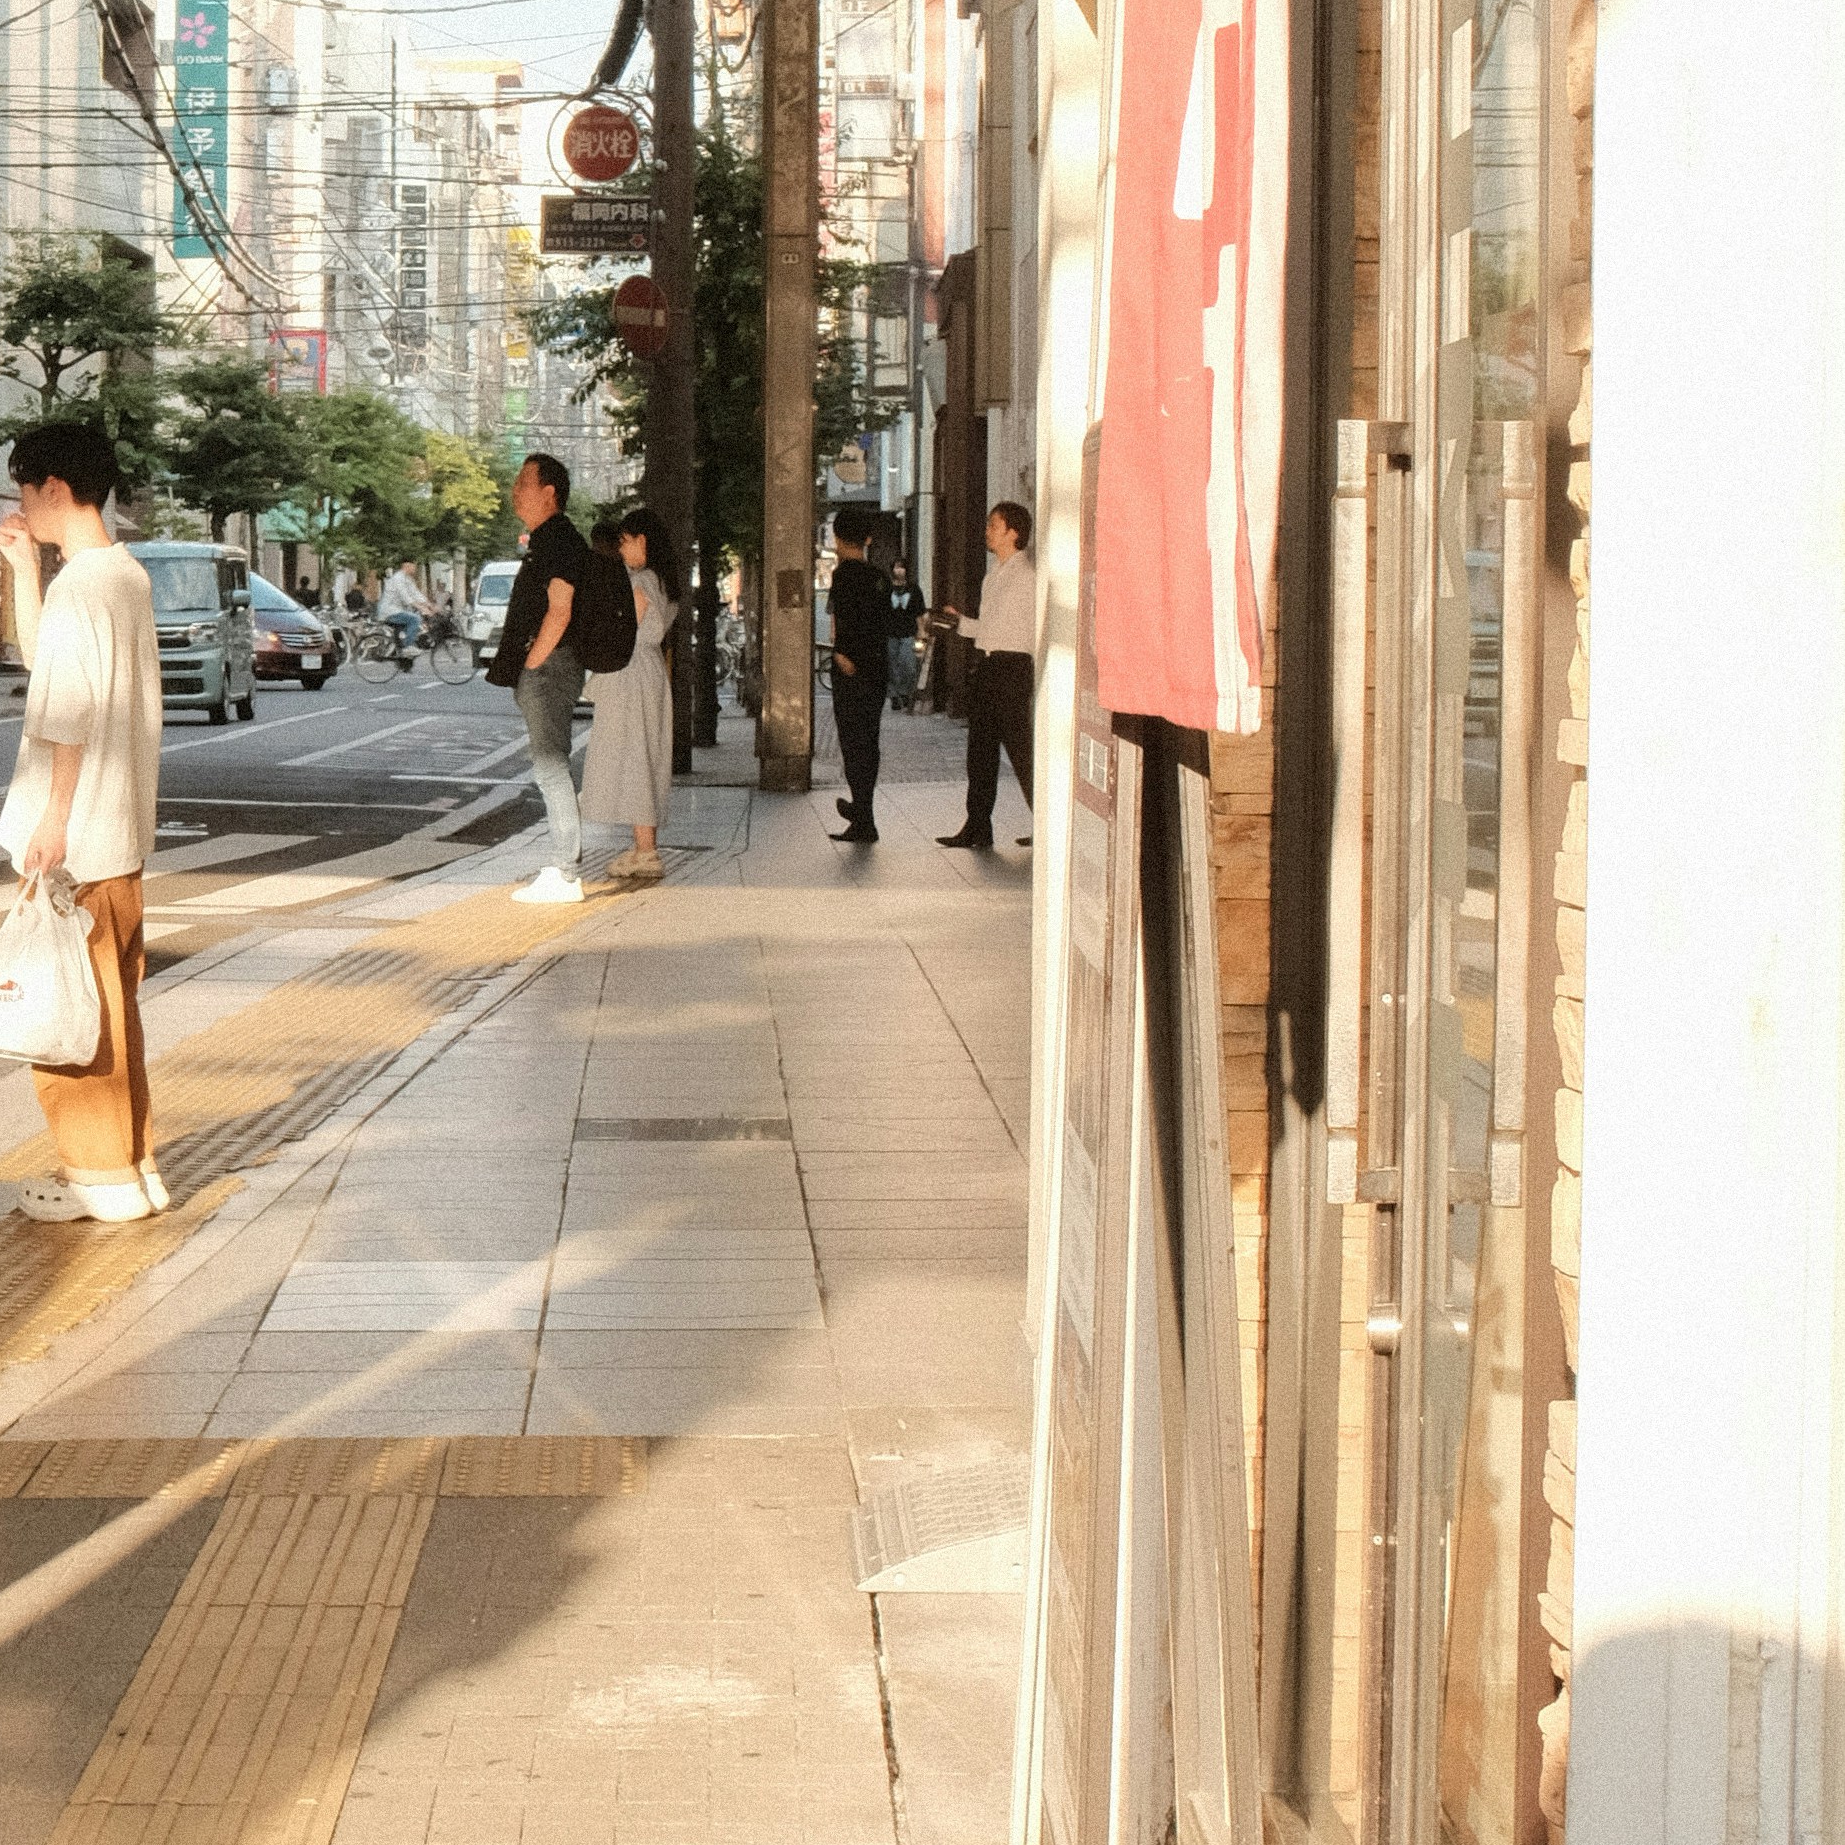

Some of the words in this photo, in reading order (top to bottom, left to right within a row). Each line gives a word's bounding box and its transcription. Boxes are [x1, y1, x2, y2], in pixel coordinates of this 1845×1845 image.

[570, 130, 633, 159] 消火栓
[571, 202, 649, 222] 福岡内科
